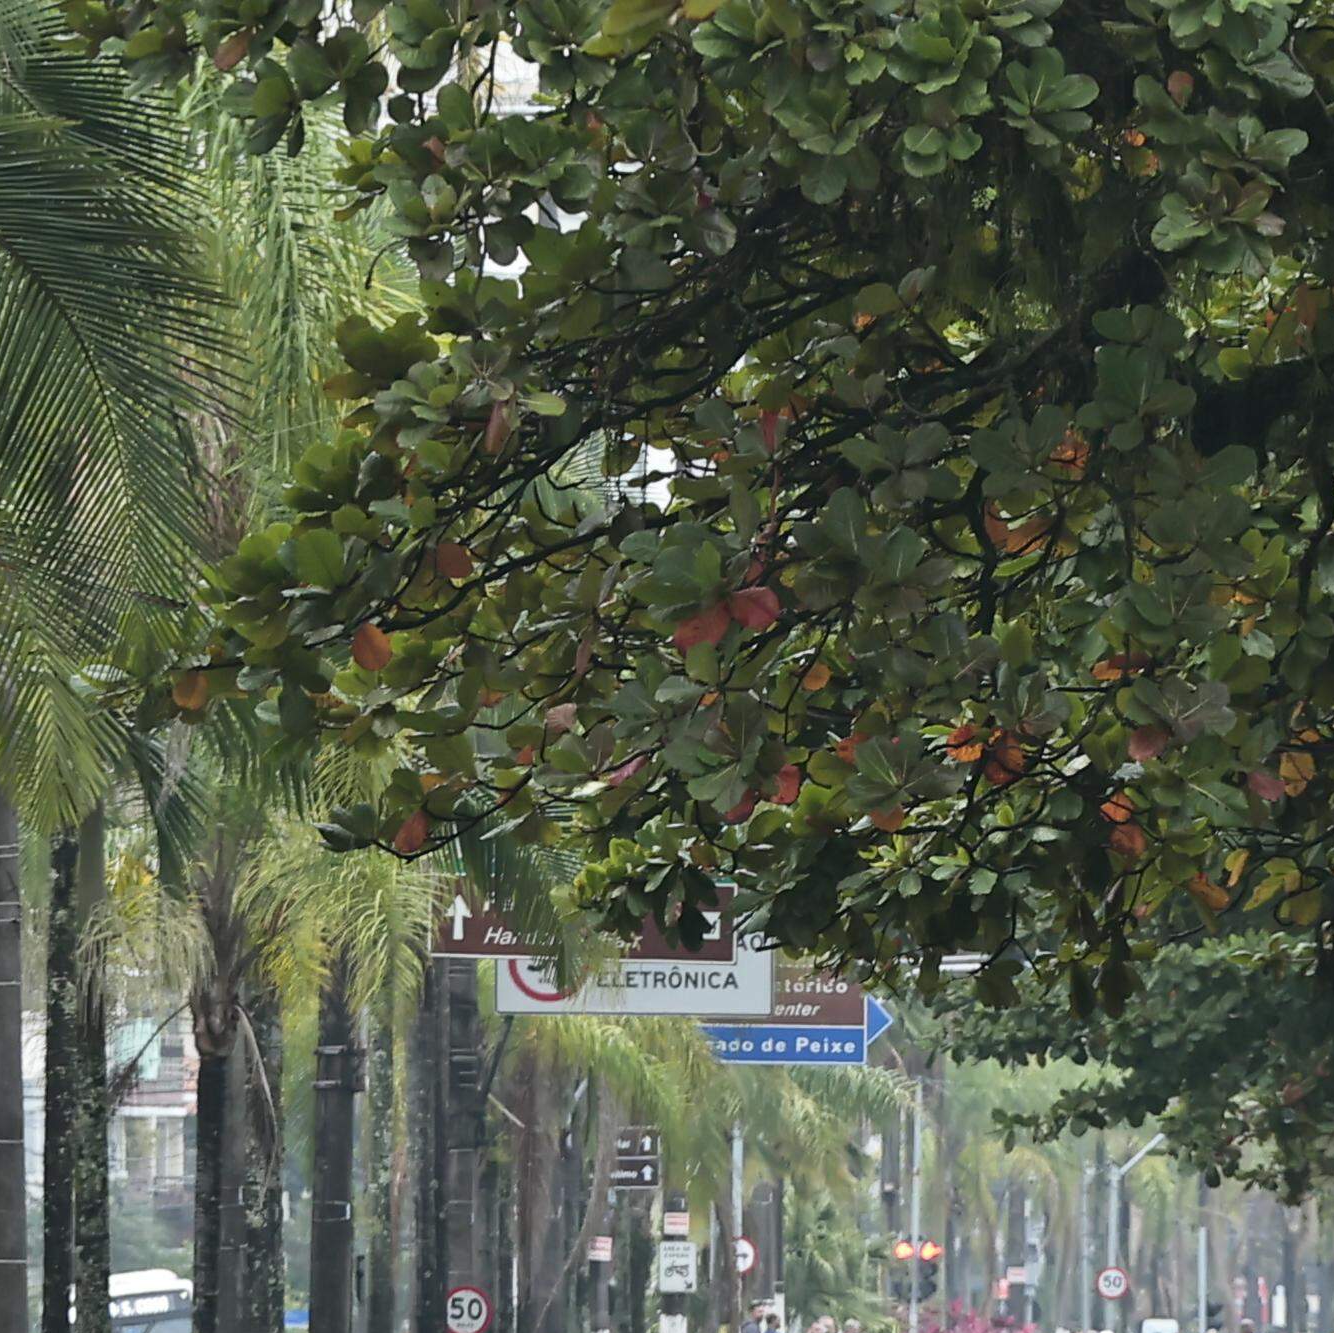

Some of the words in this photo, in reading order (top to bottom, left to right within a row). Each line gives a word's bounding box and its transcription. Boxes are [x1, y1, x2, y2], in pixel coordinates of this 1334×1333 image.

[761, 1037, 787, 1053] de
[795, 1036, 856, 1054] Peixe
[450, 1297, 483, 1320] 50
